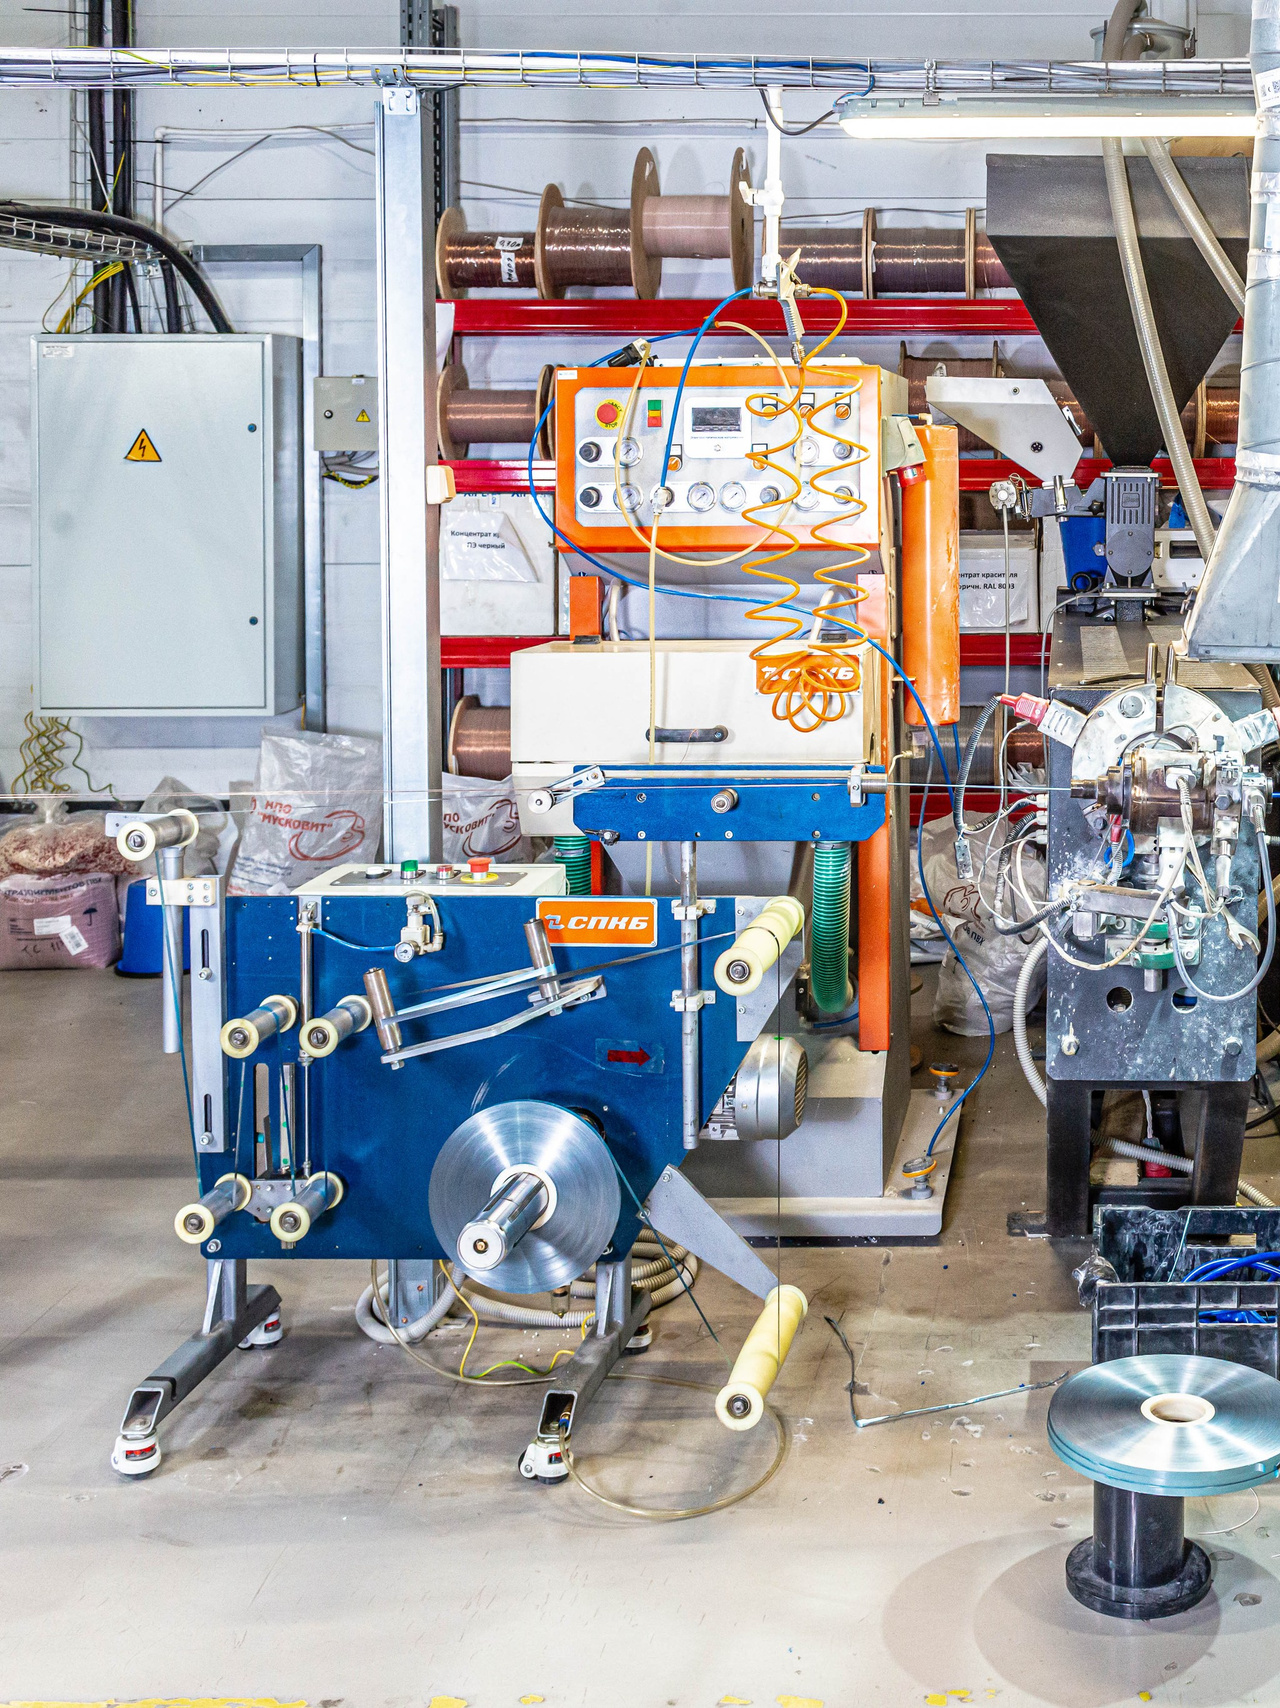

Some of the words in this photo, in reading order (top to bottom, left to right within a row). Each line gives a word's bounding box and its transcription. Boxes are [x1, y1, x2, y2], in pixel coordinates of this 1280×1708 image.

[450, 530, 491, 538] Концентрат
[264, 800, 292, 814] НПО
[567, 916, 649, 930] СПКБ
